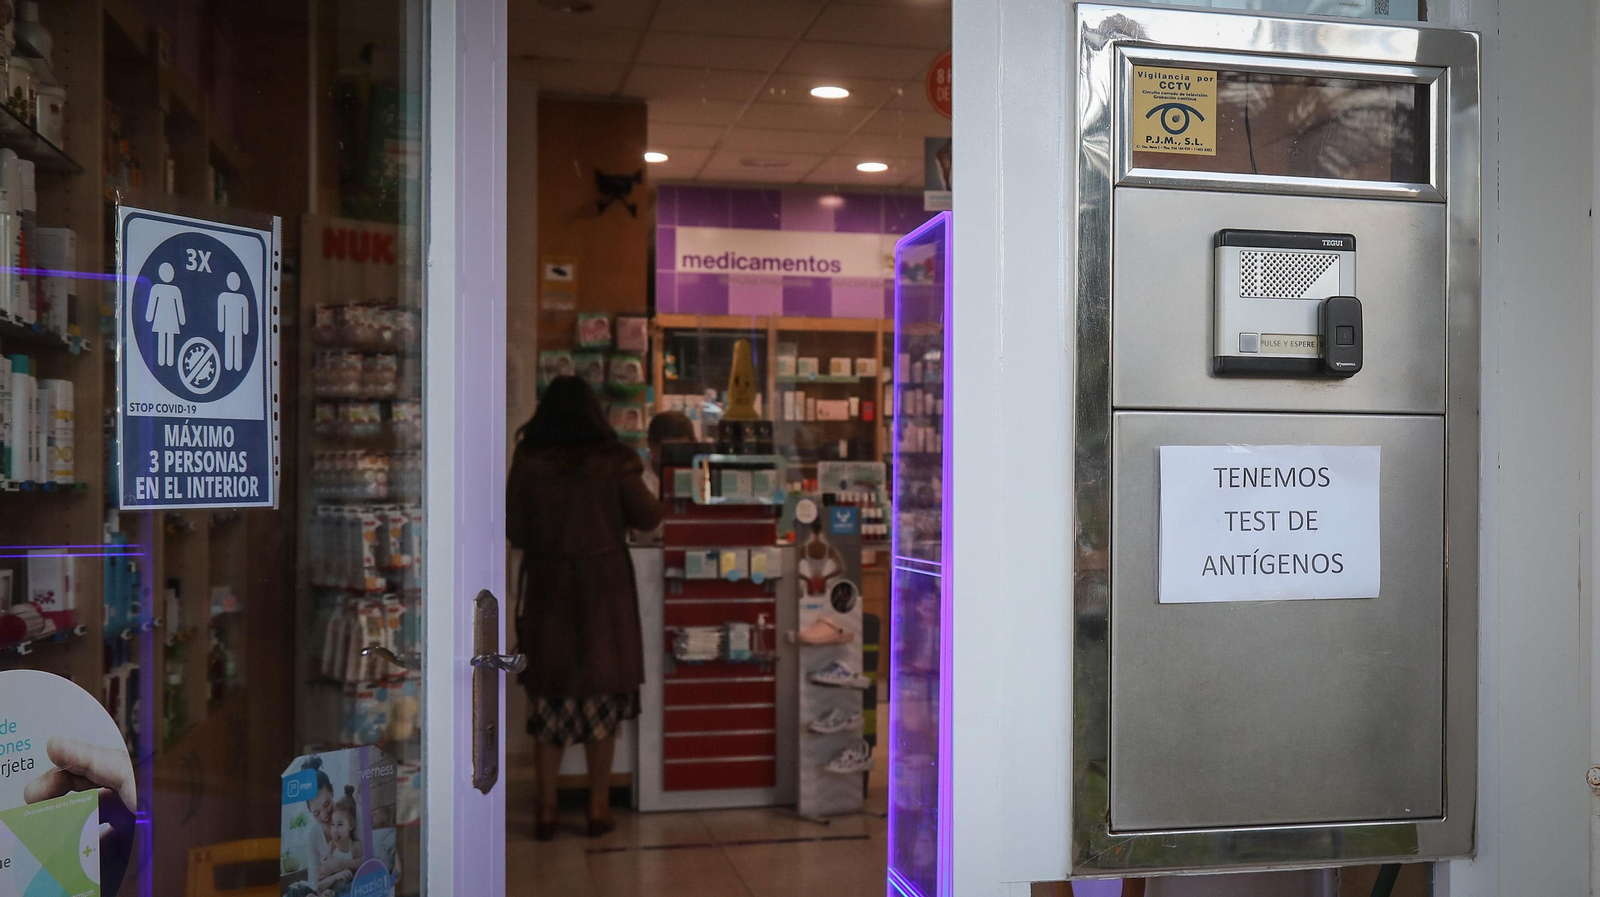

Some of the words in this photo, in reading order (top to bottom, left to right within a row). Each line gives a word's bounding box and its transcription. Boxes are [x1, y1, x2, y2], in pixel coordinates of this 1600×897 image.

[937, 68, 945, 84] 8
[1137, 71, 1190, 81] Vigilancia
[1159, 81, 1191, 91] CCTV
[1145, 135, 1181, 146] P.J.M.,
[1184, 137, 1203, 146] S.L.
[322, 226, 396, 265] NUK
[1321, 239, 1344, 247] TEGUI
[185, 248, 212, 274] 3X
[682, 251, 842, 274] medicamentos
[1261, 340, 1281, 348] PULSE
[1283, 340, 1288, 348] Y
[1290, 340, 1316, 348] ESPERE
[129, 402, 154, 413] STOP
[155, 403, 197, 414] COVID-19
[164, 419, 235, 448] MÁXIMO
[149, 449, 159, 473] 3
[164, 450, 248, 473] PERSONAS
[135, 476, 159, 500] EN
[164, 476, 182, 499] EL
[187, 475, 259, 499] INTERIOR
[1213, 466, 1331, 488] TENEMOS
[1224, 510, 1281, 532] TEST
[1288, 510, 1318, 531] DE
[1202, 548, 1344, 576] ANTÍGENOS
[0, 719, 17, 735] de
[1, 757, 35, 778] rjeta
